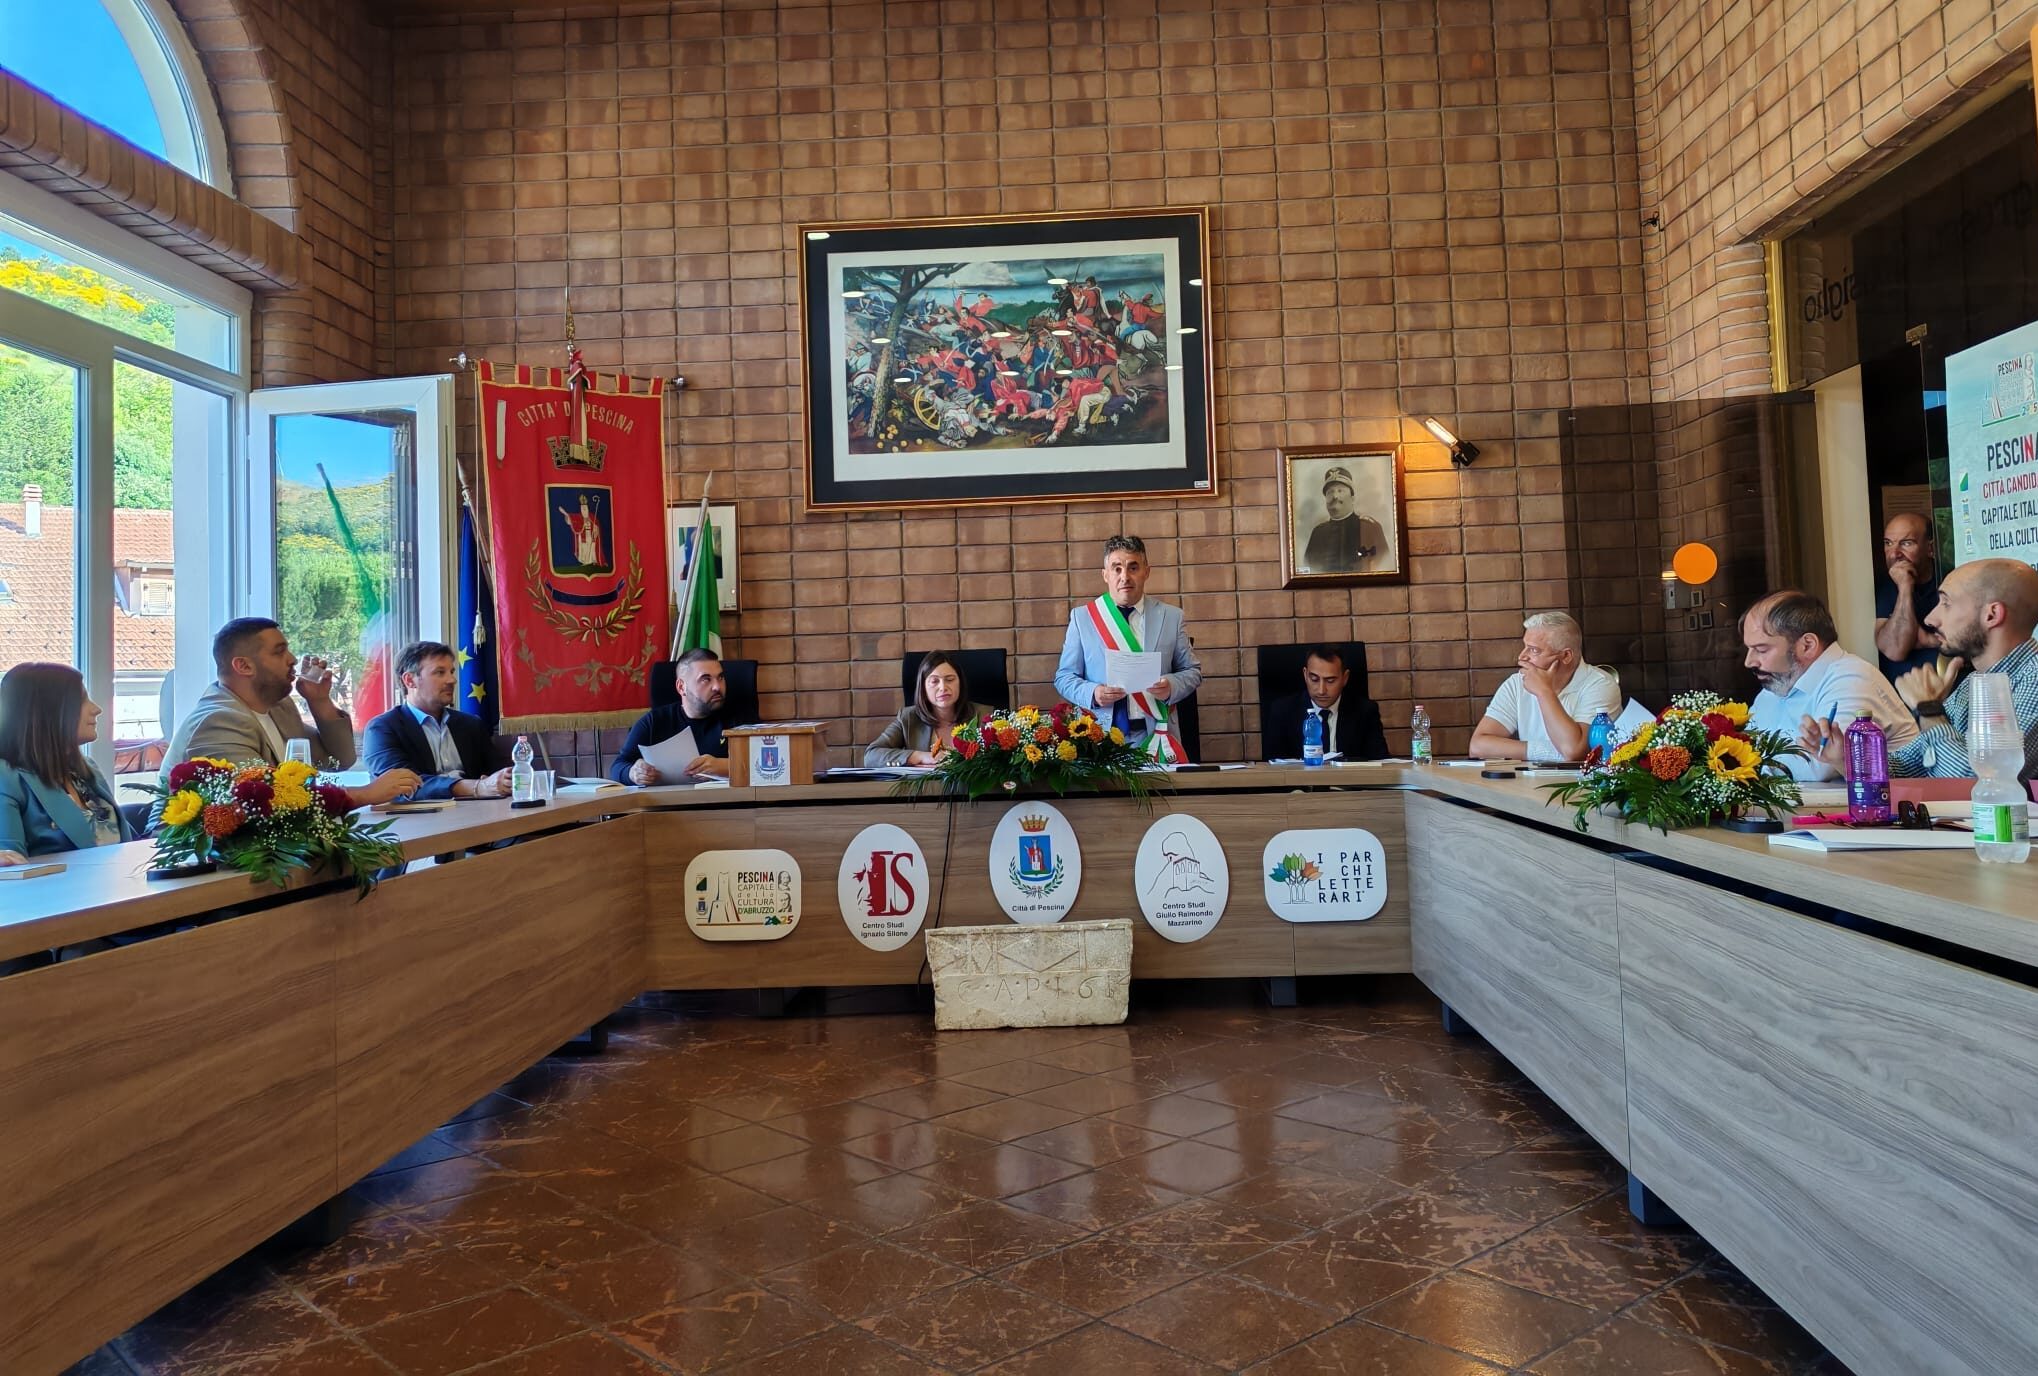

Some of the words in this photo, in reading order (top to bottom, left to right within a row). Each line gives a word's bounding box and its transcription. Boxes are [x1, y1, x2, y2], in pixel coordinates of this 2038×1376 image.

[1997, 357, 2023, 376] PESCINA
[563, 401, 571, 417] D
[1983, 476, 2004, 499] CITTÀ
[2006, 472, 2038, 494] CANDID
[1981, 503, 2018, 525] CAPITALE
[1989, 531, 2014, 550] DELLA
[1340, 851, 1372, 863] PAR
[1341, 865, 1372, 876] CHI
[737, 871, 774, 883] PESCINA
[737, 883, 774, 891] CAPITALE
[1318, 877, 1374, 890] LETTE
[737, 898, 774, 906] CULTURA
[1012, 904, 1028, 912] Città
[1156, 911, 1177, 919] Giulio
[1178, 910, 1213, 918] Raimondo
[1167, 919, 1202, 927] Mazzarino
